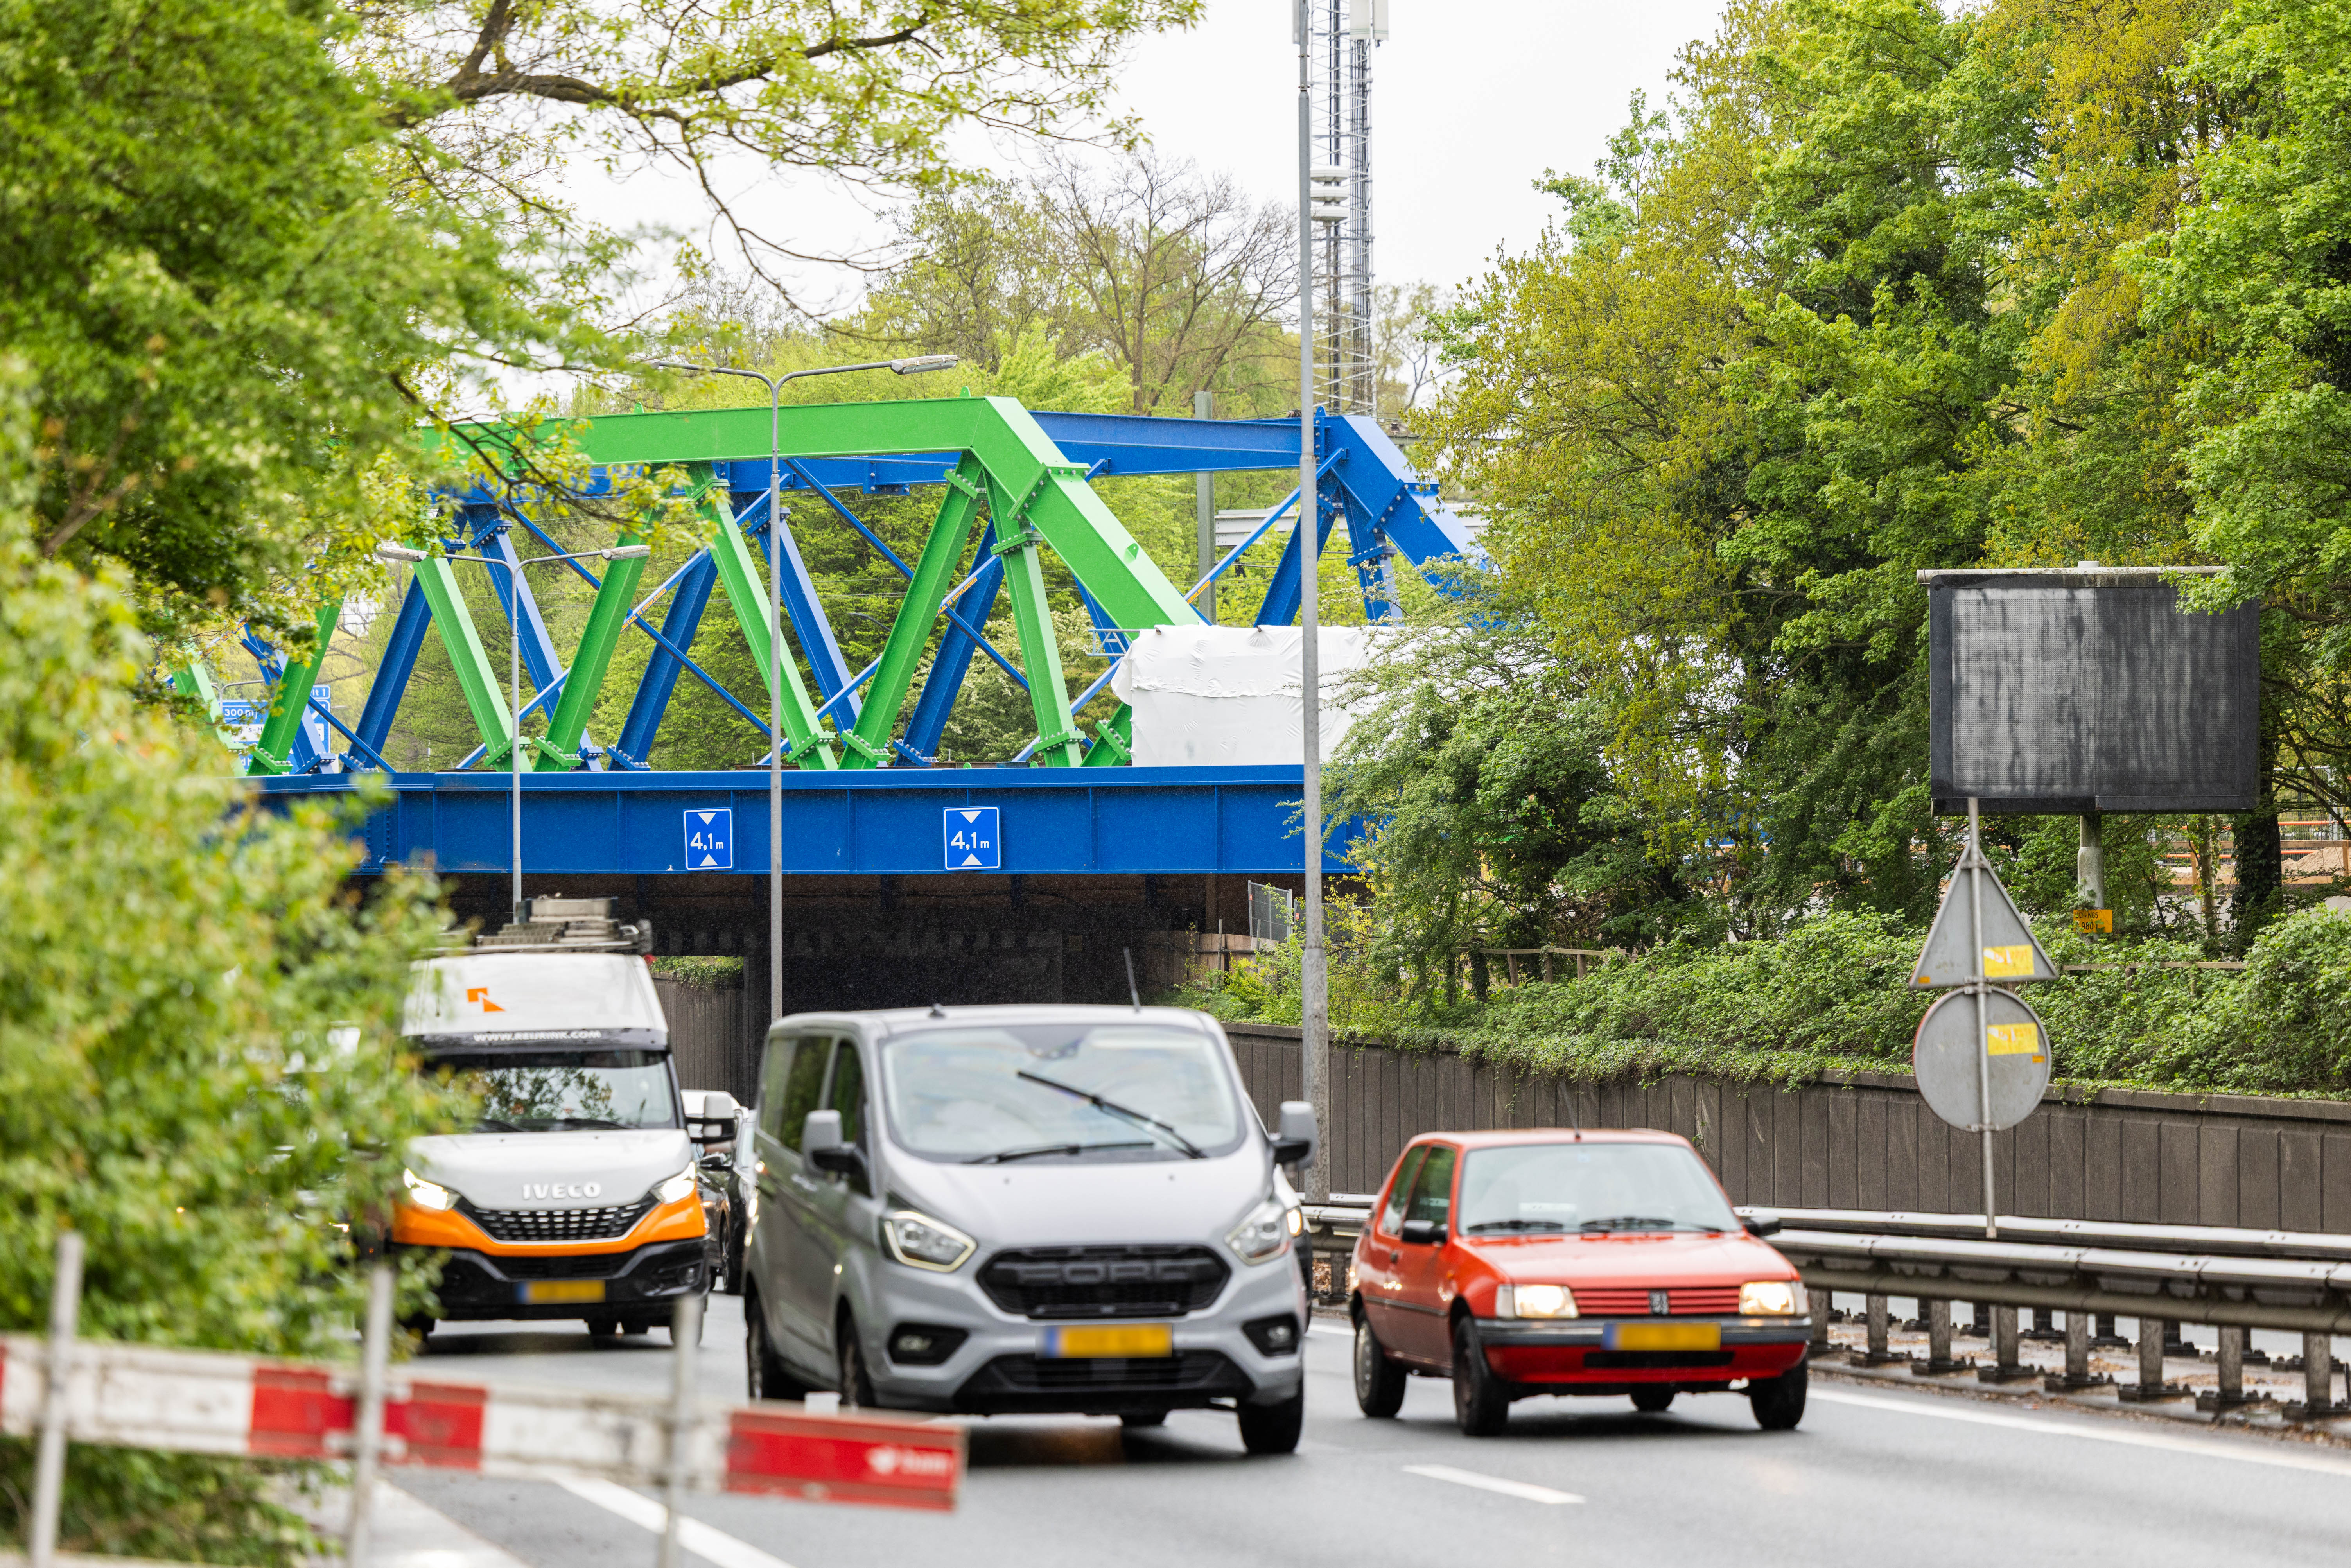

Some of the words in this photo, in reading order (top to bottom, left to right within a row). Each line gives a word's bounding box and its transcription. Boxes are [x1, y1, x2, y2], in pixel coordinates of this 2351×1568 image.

[951, 576, 978, 602] VERWIJDEREN
[641, 588, 667, 612] VERWIJDEREN
[690, 832, 713, 851] 4,1
[951, 831, 976, 850] 4,1
[523, 1182, 601, 1200] IVECO
